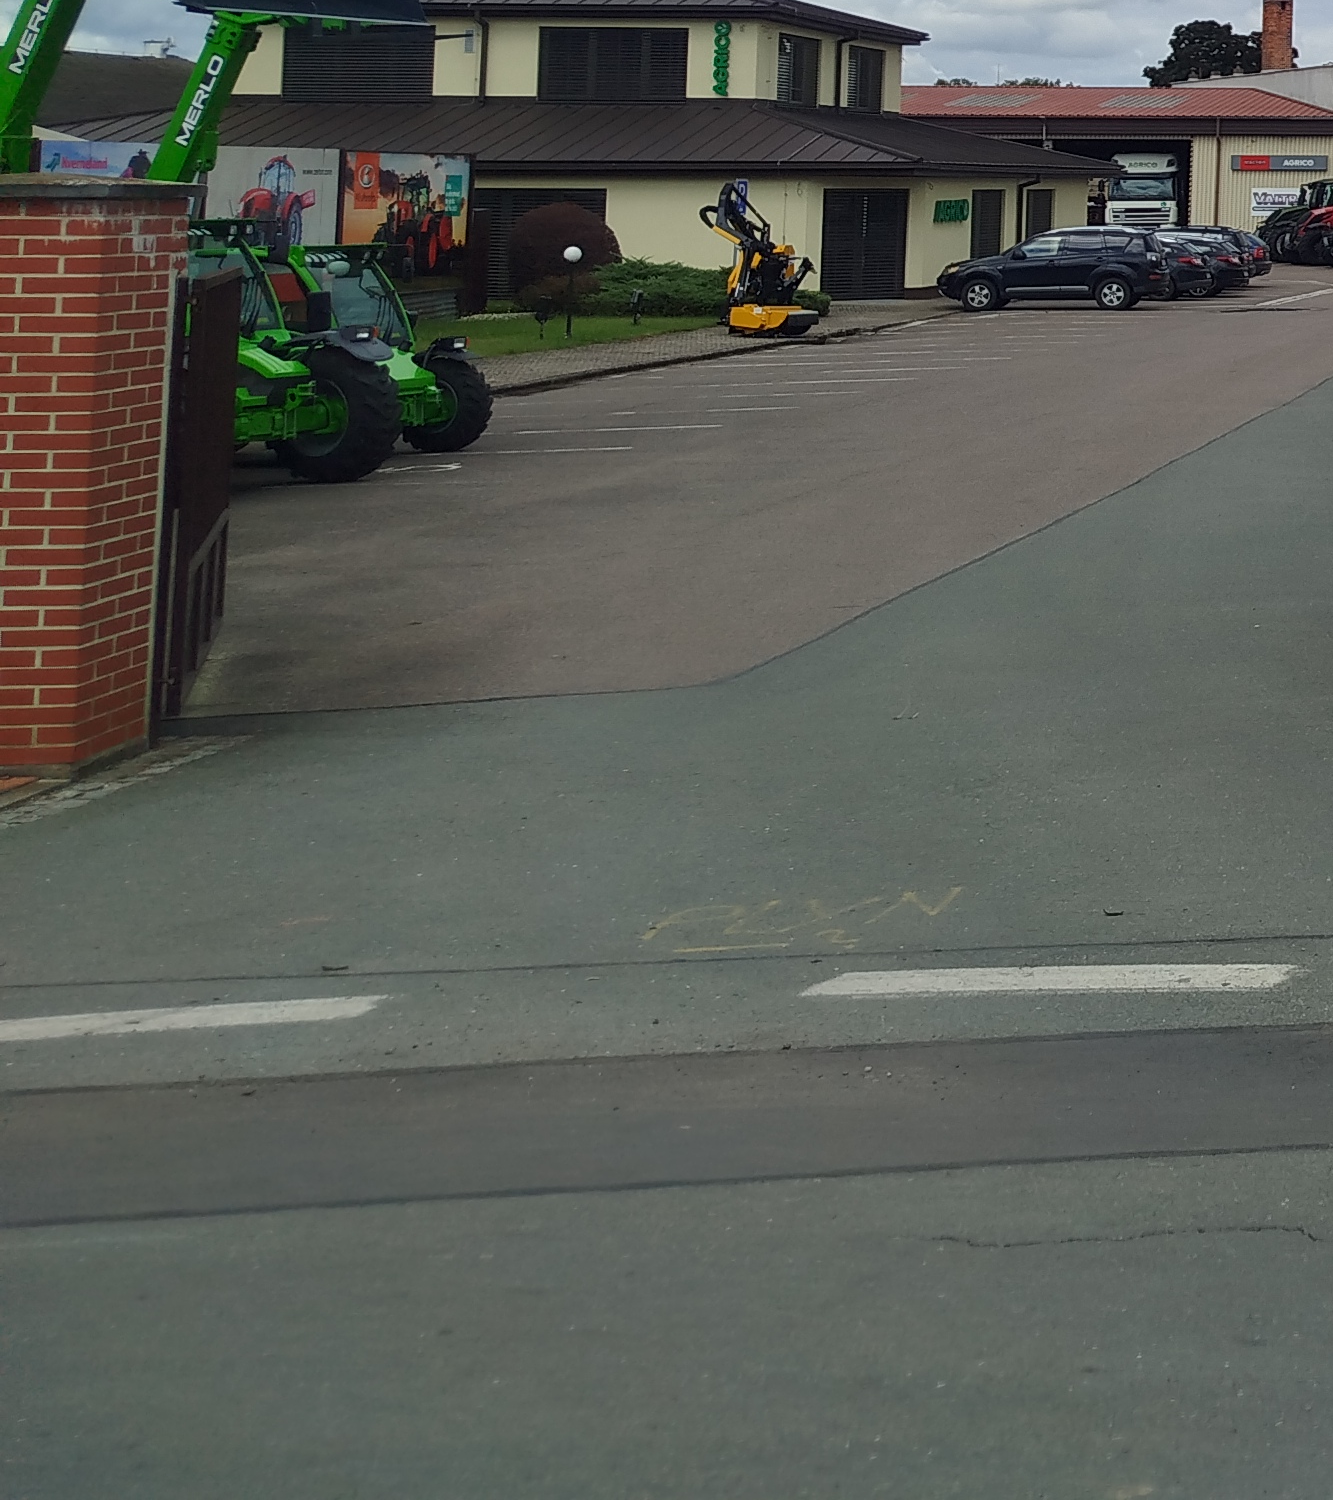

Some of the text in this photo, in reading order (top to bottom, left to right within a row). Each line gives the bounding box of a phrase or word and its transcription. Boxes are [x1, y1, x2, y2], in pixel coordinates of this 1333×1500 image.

[713, 20, 731, 96] AGRICO
[174, 54, 225, 147] MERLO
[1282, 158, 1315, 167] AGRICO
[1253, 192, 1299, 206] VALTR
